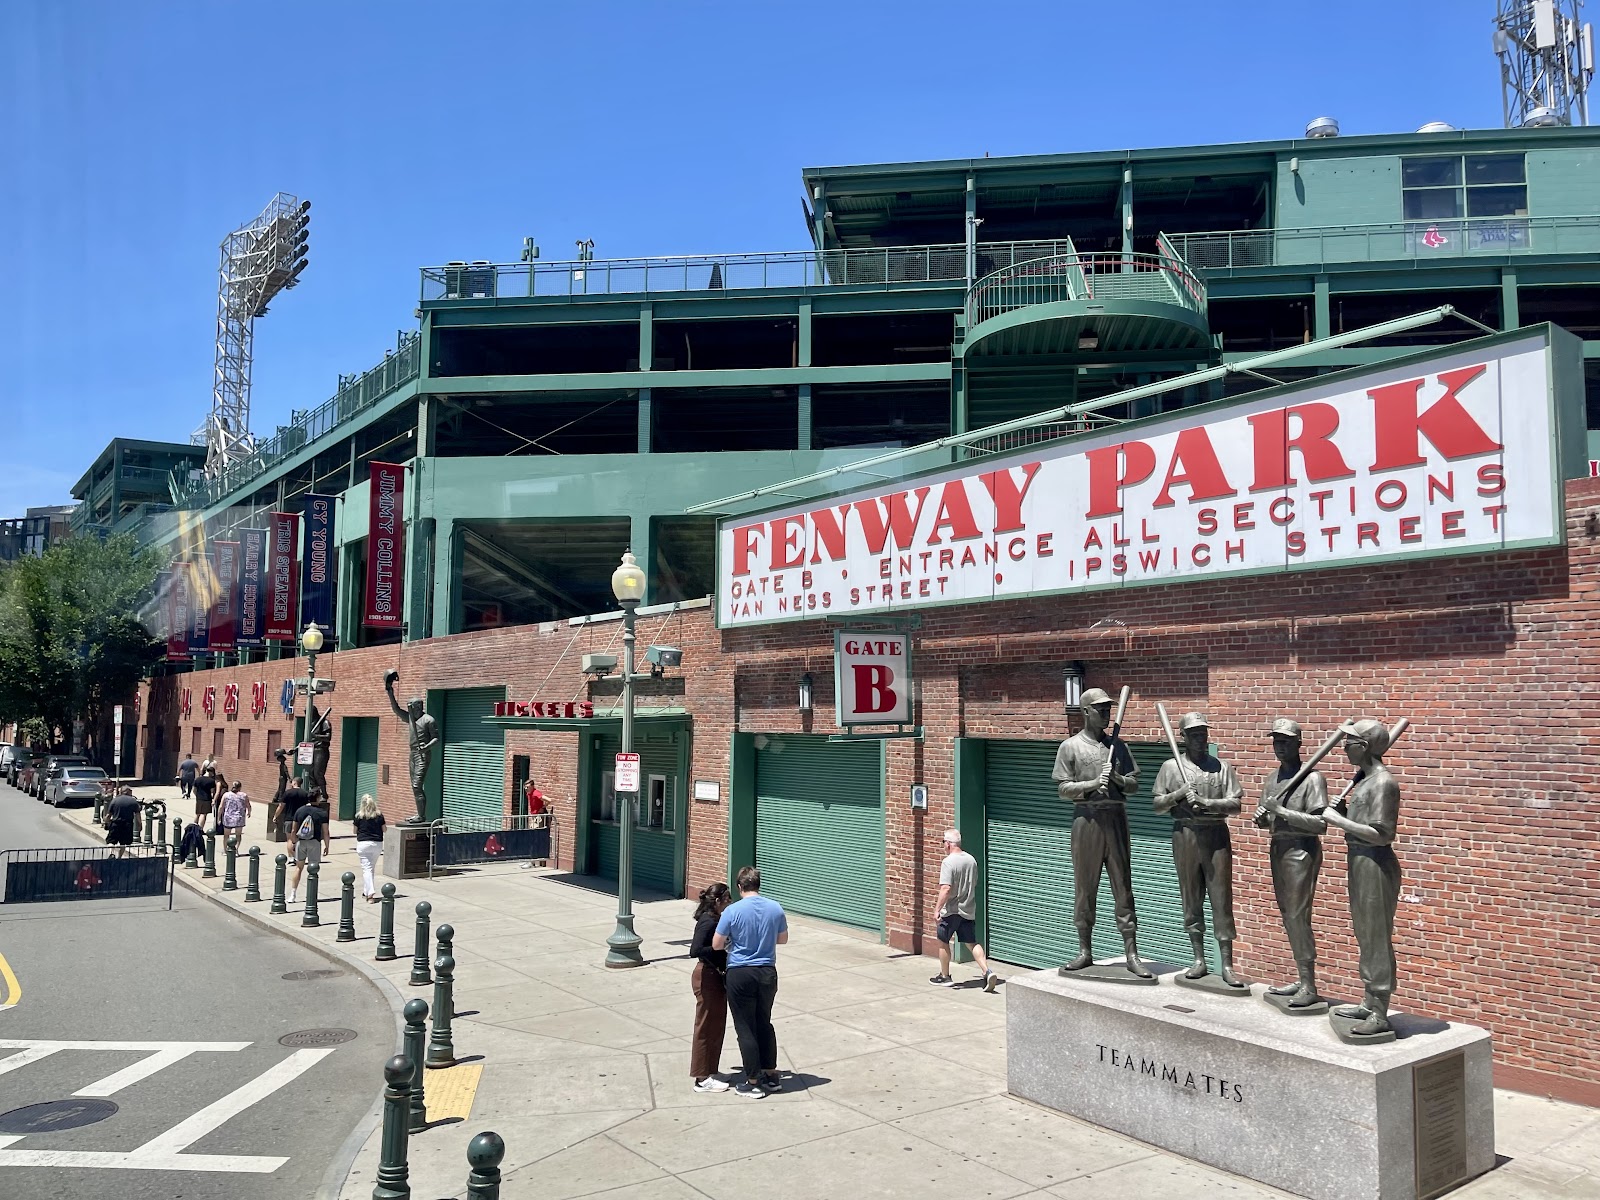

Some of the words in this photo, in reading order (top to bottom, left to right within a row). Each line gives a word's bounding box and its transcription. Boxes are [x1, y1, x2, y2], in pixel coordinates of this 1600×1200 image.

[732, 461, 1042, 577] FENWAY
[1085, 364, 1504, 519] PARK
[313, 500, 327, 524] CY
[379, 470, 396, 534] JIMMY
[245, 533, 259, 581] HARRY
[276, 520, 291, 553] TRIS
[311, 528, 327, 583] YOUNG
[731, 575, 784, 600] GATE
[802, 571, 813, 590] B
[880, 532, 1053, 579] ENTRANCE
[1084, 517, 1160, 551] ALL
[1197, 464, 1506, 537] SECTIONS
[220, 546, 233, 578] BABE
[376, 539, 394, 613] COLLINS
[731, 599, 763, 619] VAN
[779, 591, 832, 613] NESS
[850, 576, 949, 605] STREET
[1069, 539, 1244, 581] IPSWICH
[1287, 504, 1507, 557] STREET
[243, 584, 257, 635] HOOPER
[274, 556, 289, 621] SPEAKER
[845, 640, 902, 655] GATE
[202, 685, 215, 715] 45
[223, 682, 238, 714] 26
[252, 681, 267, 715] 34
[280, 678, 295, 714] 42
[494, 701, 594, 718] TICKETS
[851, 664, 897, 714] B
[1096, 1044, 1243, 1103] TEAMMATES
